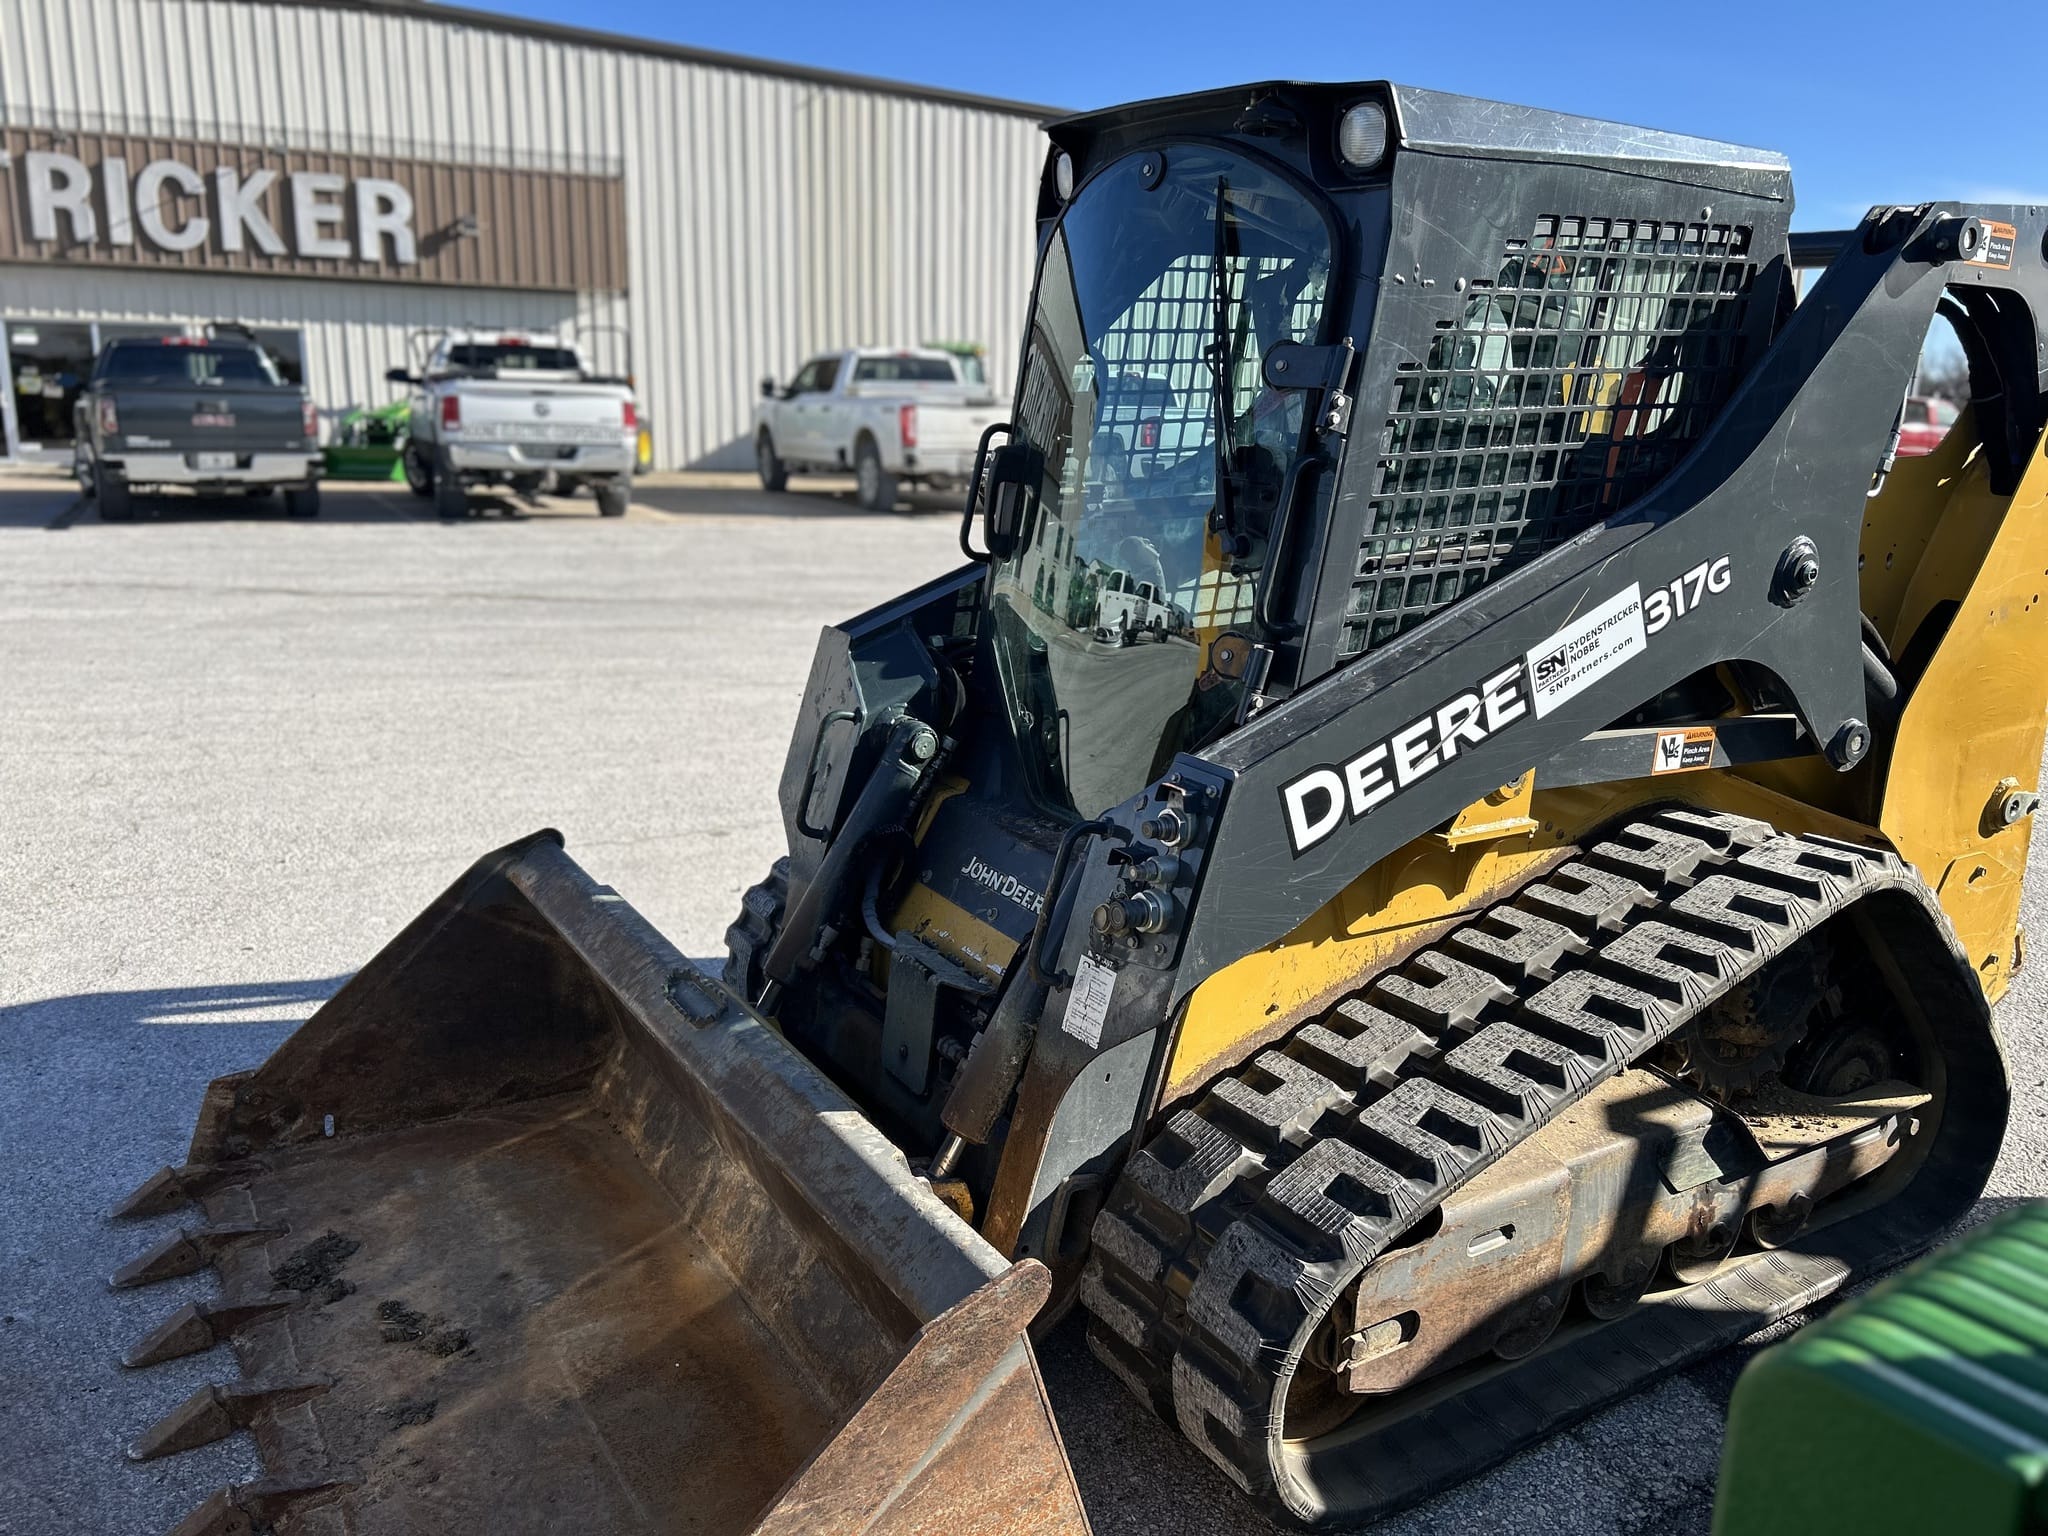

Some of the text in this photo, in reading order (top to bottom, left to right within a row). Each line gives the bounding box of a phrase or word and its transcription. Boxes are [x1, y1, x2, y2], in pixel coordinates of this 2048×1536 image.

[0, 150, 417, 264] RICKER
[1643, 554, 1732, 636] 317G
[1568, 601, 1640, 653] SYDENSTRICKER
[1570, 637, 1601, 664] NOBBE
[1538, 667, 1568, 688] PARTNERS
[1548, 636, 1633, 696] SNPartners.com
[1284, 662, 1528, 851] DEERE
[1684, 746, 1698, 755] Pinch
[1691, 730, 1713, 739] WARNING
[961, 856, 1045, 914] JOHN DEER
